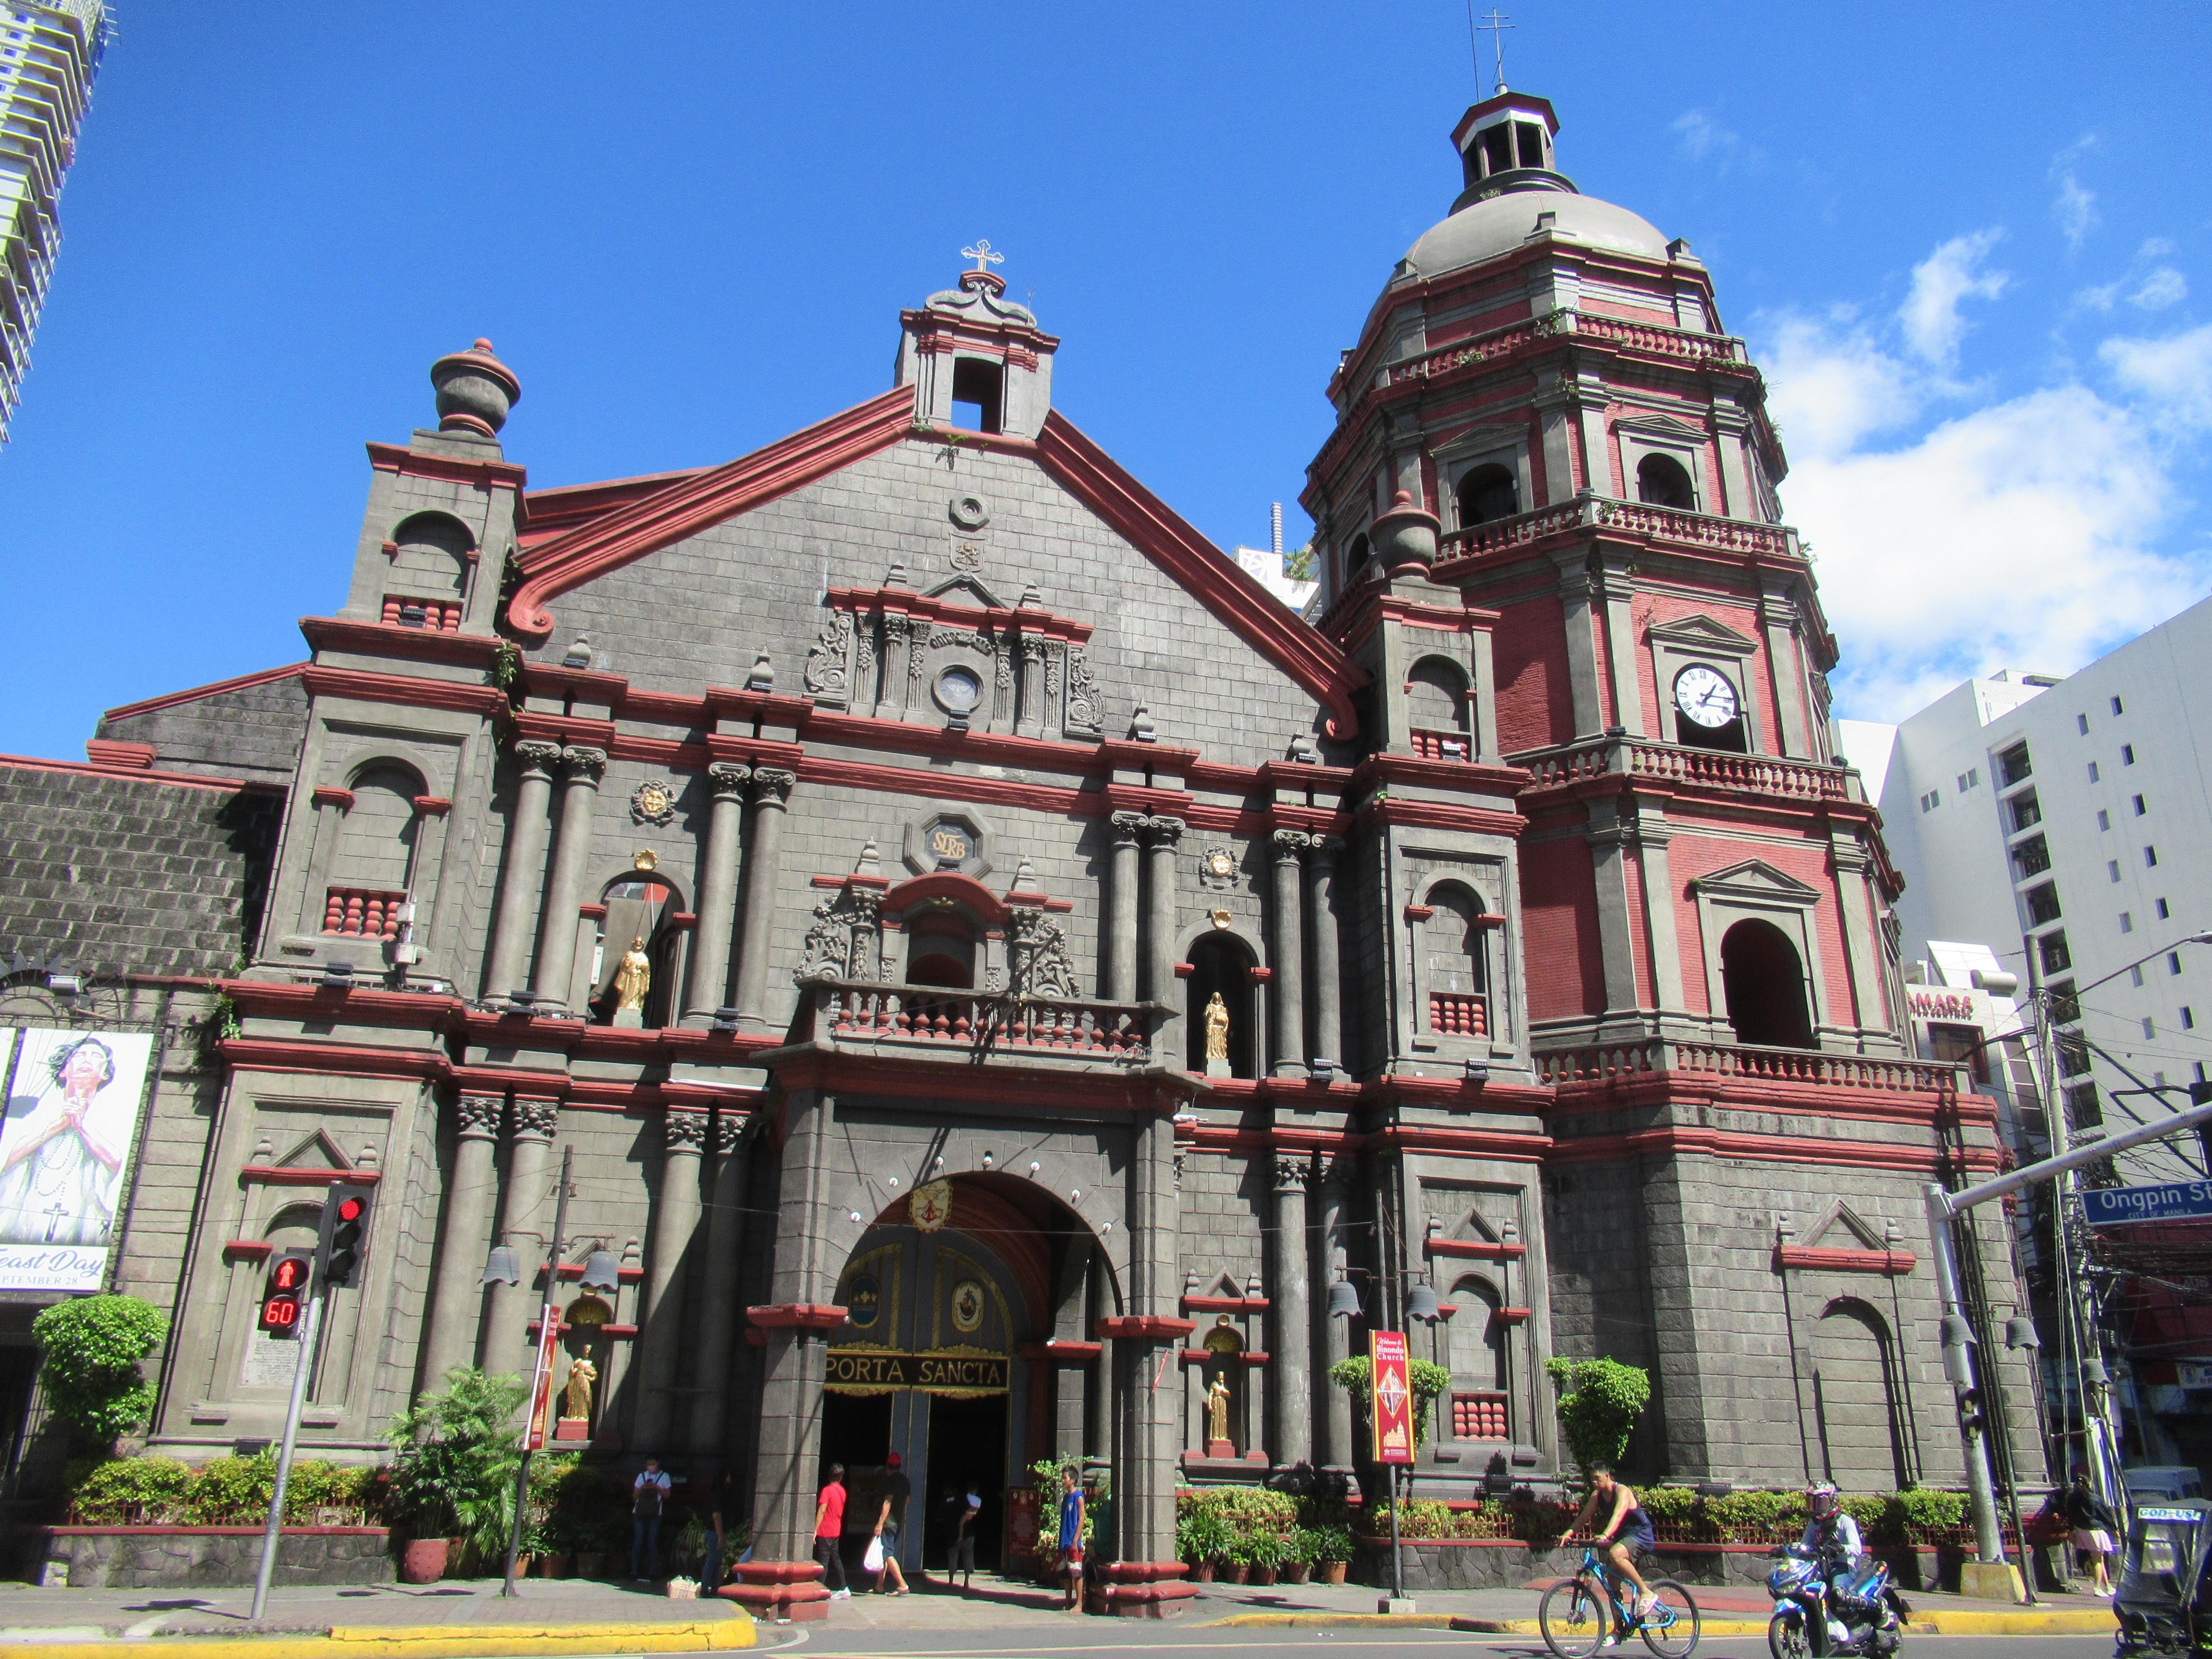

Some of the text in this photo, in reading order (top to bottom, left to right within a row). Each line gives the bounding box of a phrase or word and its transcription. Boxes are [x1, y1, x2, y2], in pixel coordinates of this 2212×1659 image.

[1906, 991, 1974, 1013] AMADA
[2101, 1186, 2182, 1211] Ongpin
[2128, 1208, 2193, 1220] CITY OF MANILA
[48, 1250, 105, 1278] Day
[0, 1275, 78, 1285] PTEMBER 28
[265, 1302, 294, 1324] 60
[1377, 1345, 1404, 1354] Binondo
[1377, 1352, 1404, 1361] Church
[919, 1360, 1001, 1385] SANCTA
[2140, 1509, 2167, 1517] GOD
